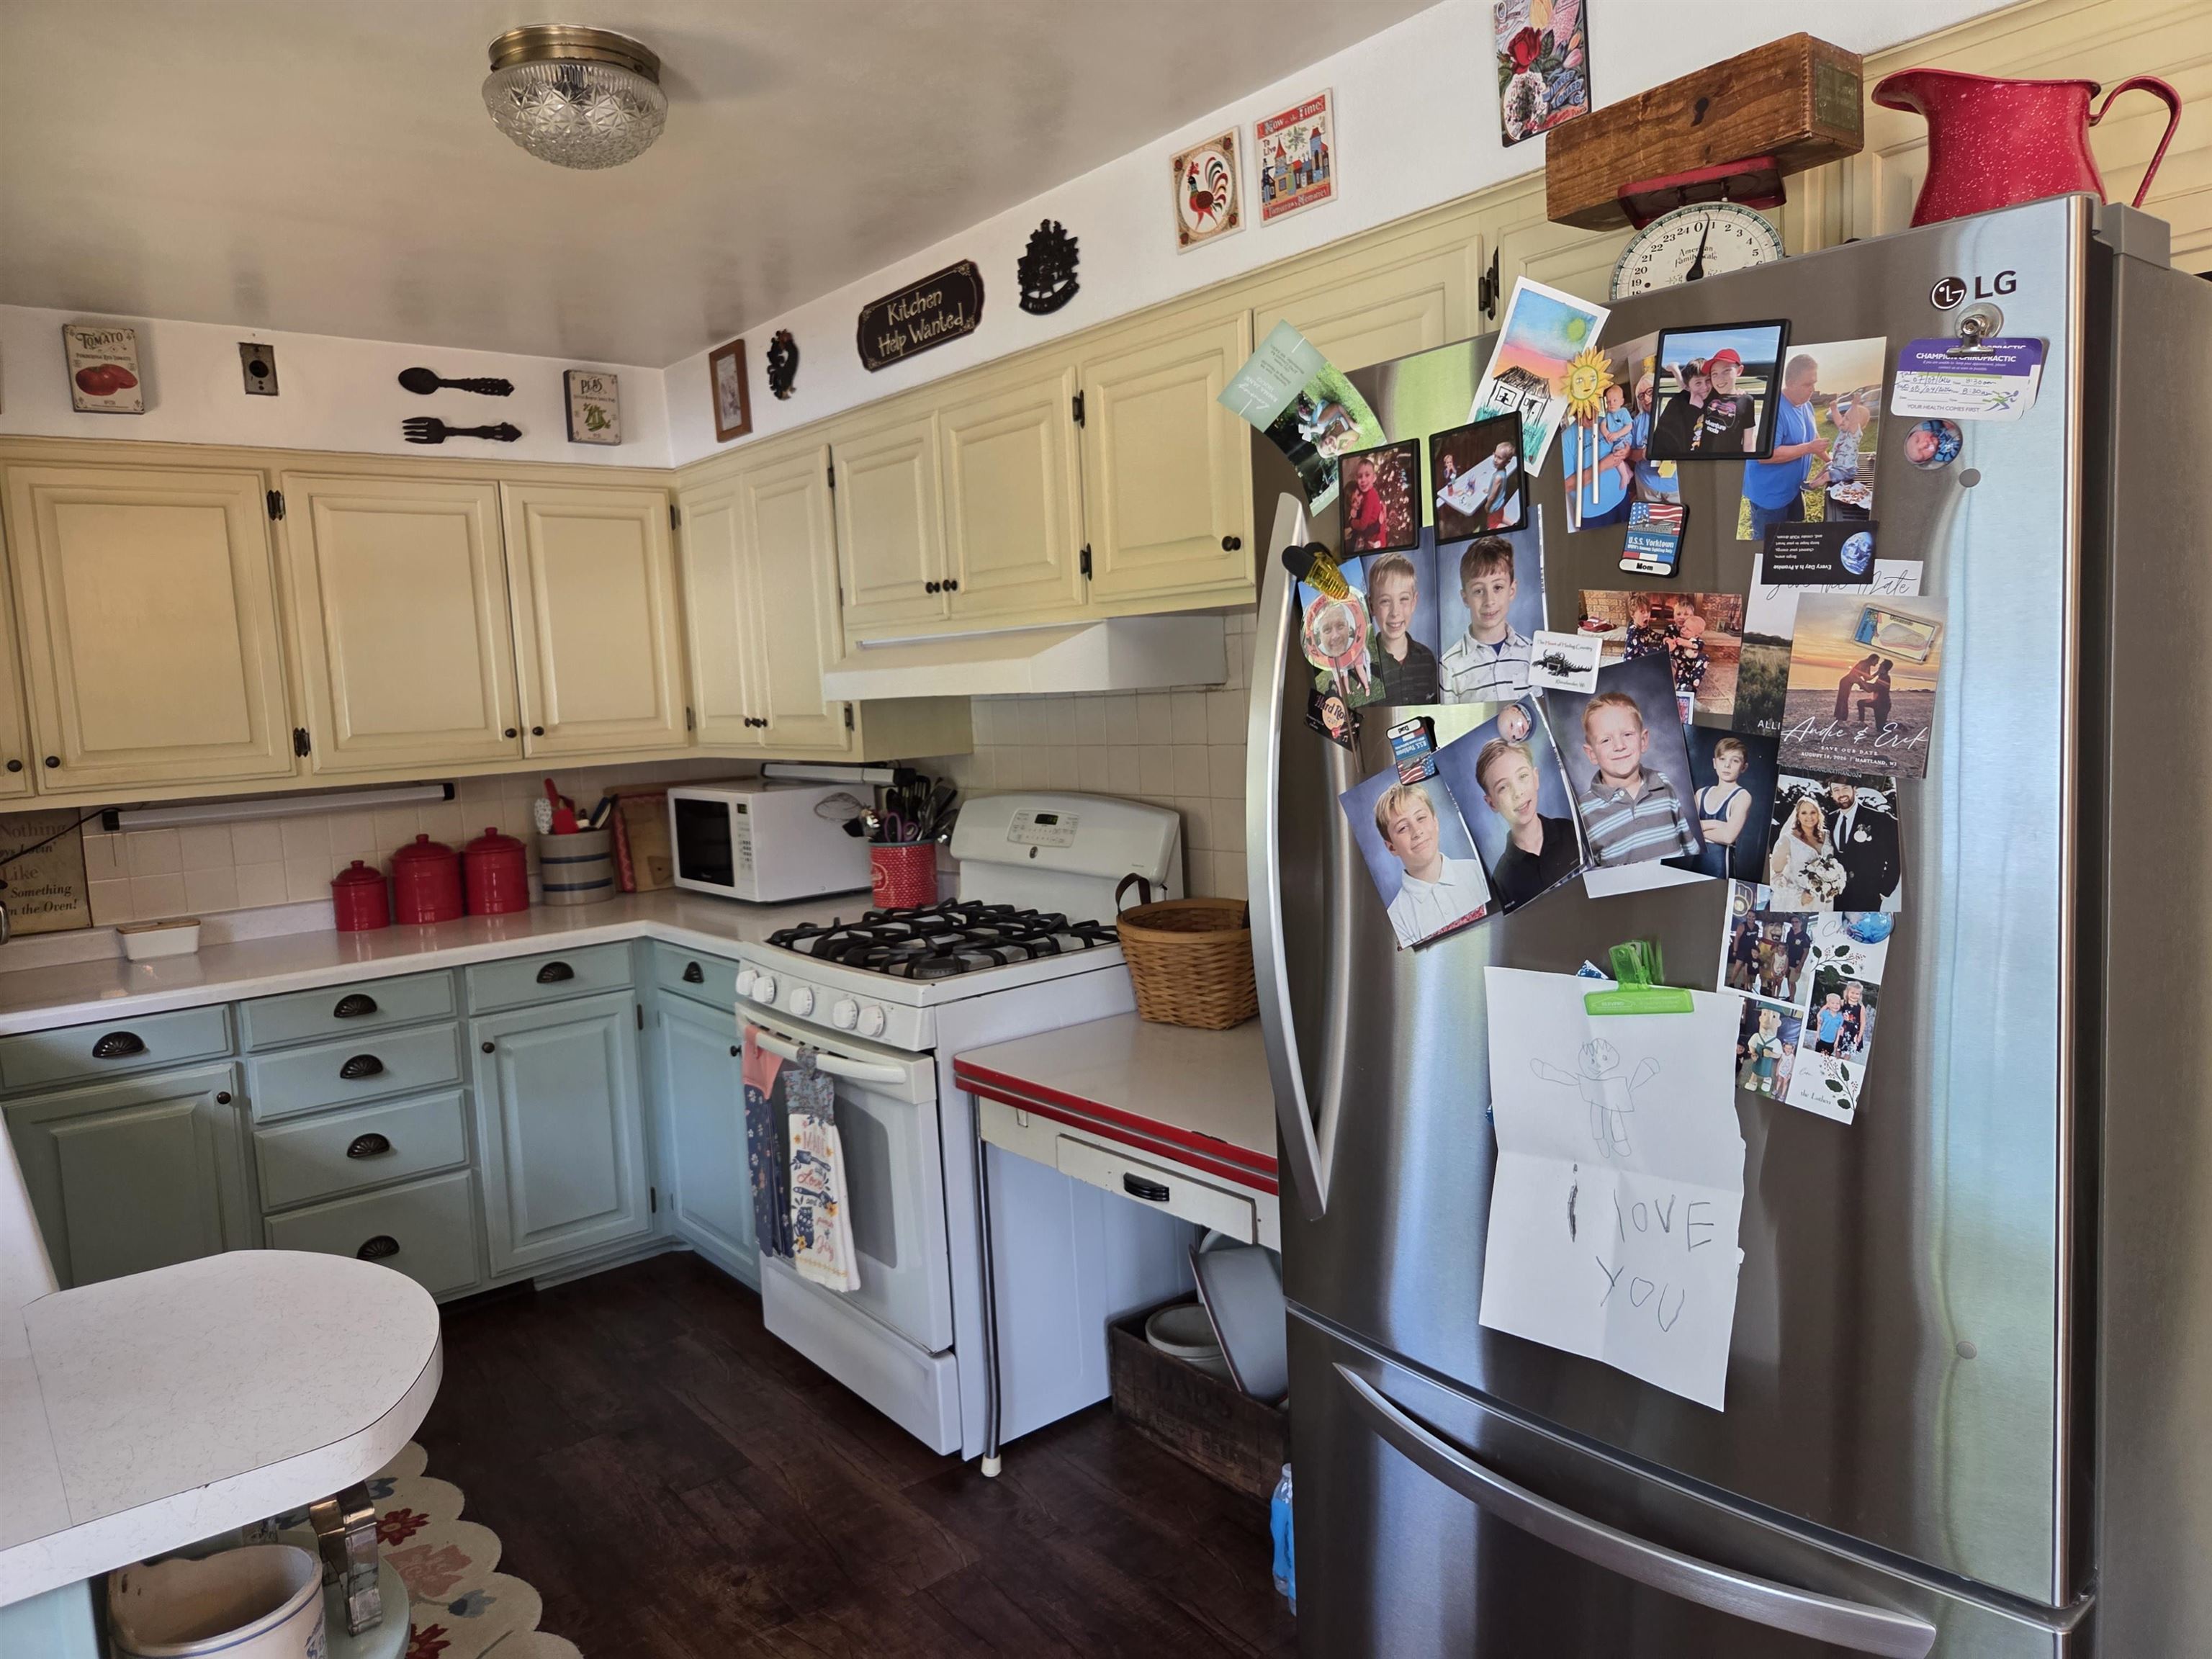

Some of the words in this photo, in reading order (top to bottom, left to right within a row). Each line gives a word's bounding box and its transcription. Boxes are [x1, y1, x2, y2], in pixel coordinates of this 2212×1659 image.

[1677, 227, 1689, 235] 24
[1694, 222, 1703, 232] 0
[1663, 234, 1676, 243] 23
[1651, 244, 1663, 253] 22
[1635, 266, 1648, 275] 20
[1975, 270, 2016, 300] LG
[887, 289, 943, 326] Kitchen
[878, 330, 907, 357] Help
[908, 302, 963, 343] Wanted
[1646, 539, 1674, 548] Yorktown
[1636, 562, 1653, 571] Mom
[1315, 694, 1335, 714] Hard
[1398, 725, 1409, 734] Dad
[1781, 716, 1846, 743] Andie
[1853, 727, 1868, 745] &
[1874, 722, 1928, 750] Erik
[1, 865, 39, 881] Like
[11, 884, 72, 899] Something
[22, 904, 40, 915] the
[44, 899, 77, 913] Oven!
[1596, 1255, 1685, 1333] YOU
